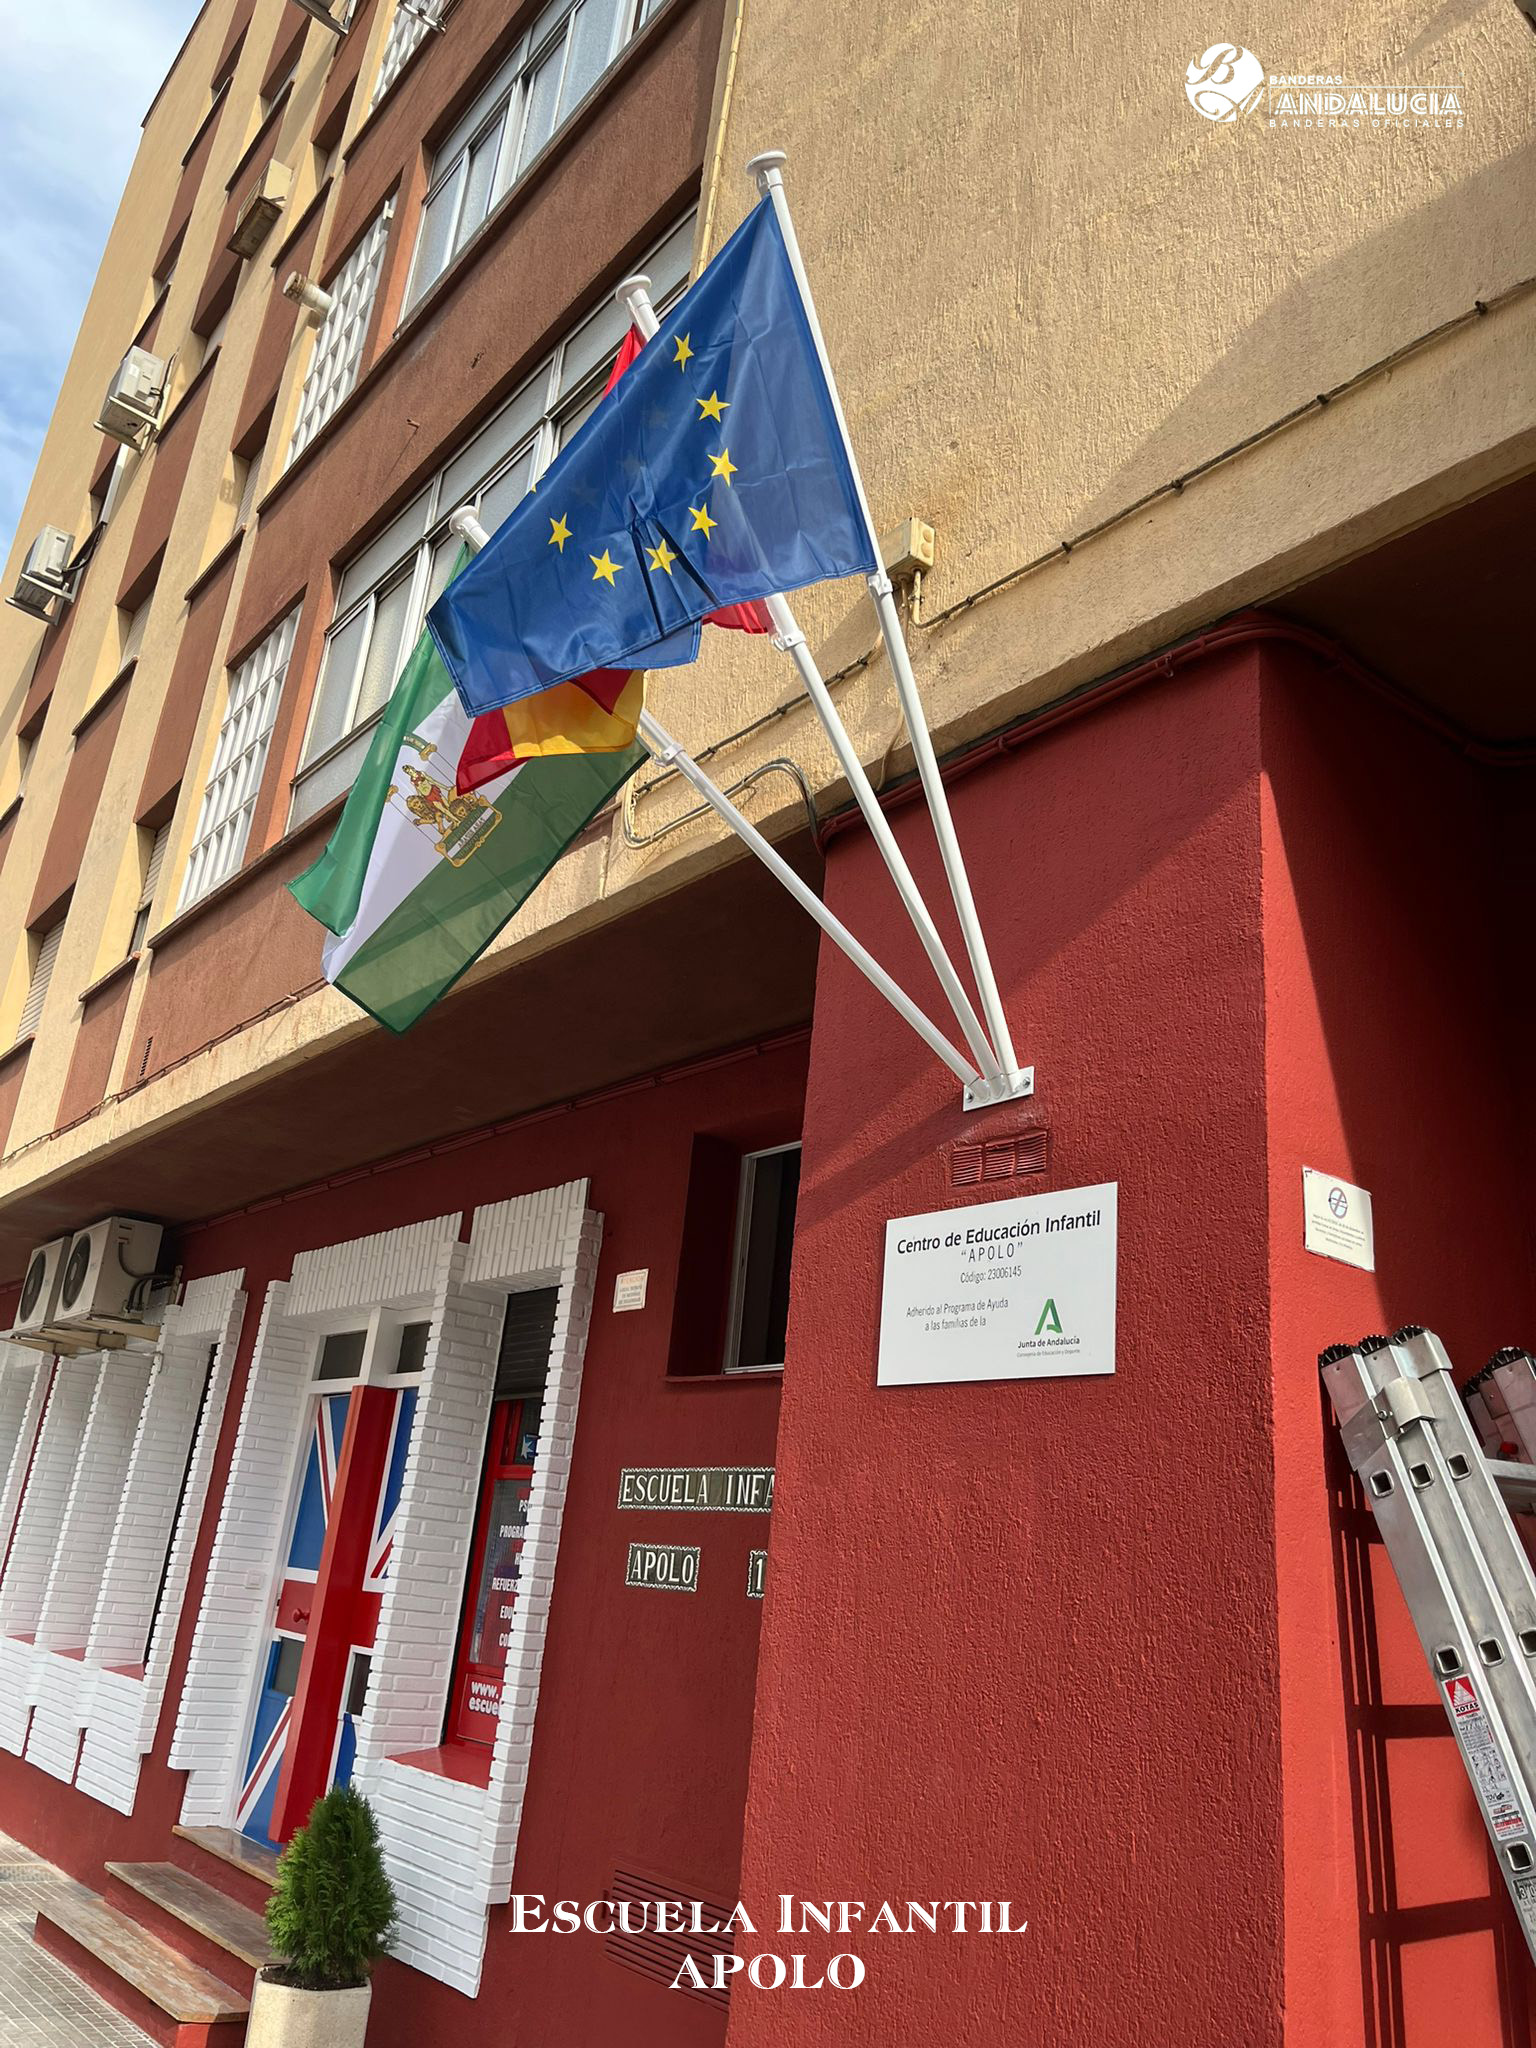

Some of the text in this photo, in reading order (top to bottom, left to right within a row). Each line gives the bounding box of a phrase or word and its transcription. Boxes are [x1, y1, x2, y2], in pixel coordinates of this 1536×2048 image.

[897, 1209, 1101, 1254] Centro de Educación Infantil
[960, 1265, 1022, 1285] Código: 23006145
[906, 1297, 1009, 1318] Adherido al Programa de Ayuda
[924, 1315, 986, 1331] a las familias de la
[1018, 1335, 1080, 1349] Junta de Andalucía
[622, 1474, 708, 1503] ESCUELA
[630, 1550, 695, 1584] APOLO
[471, 1681, 499, 1699] www.
